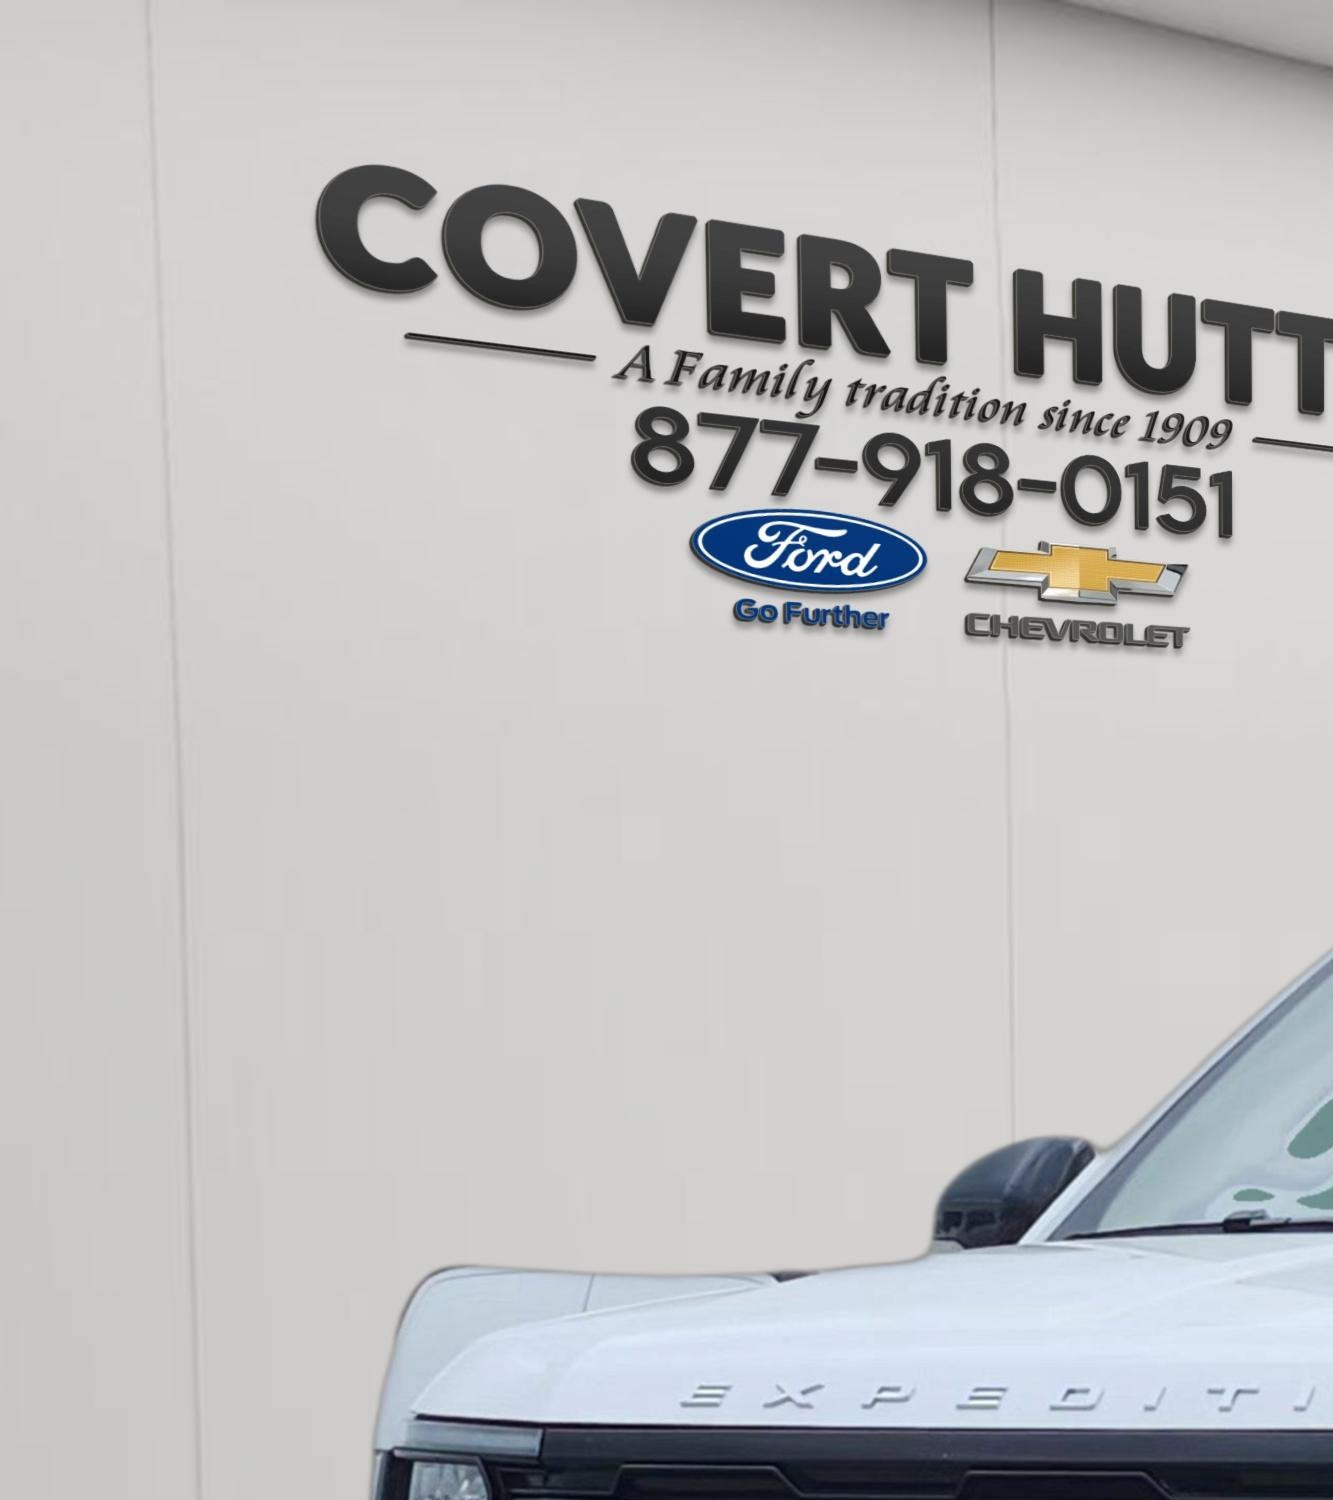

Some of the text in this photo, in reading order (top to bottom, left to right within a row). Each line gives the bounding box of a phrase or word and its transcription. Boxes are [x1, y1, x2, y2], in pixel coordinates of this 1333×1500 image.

[315, 164, 974, 366] COVERT
[611, 345, 1234, 450] A Family tradition since 1909
[630, 405, 1233, 539] 877-918-0151
[743, 520, 882, 578] Ford
[733, 598, 890, 630] Go Further
[964, 612, 1190, 650] CHEVROLET
